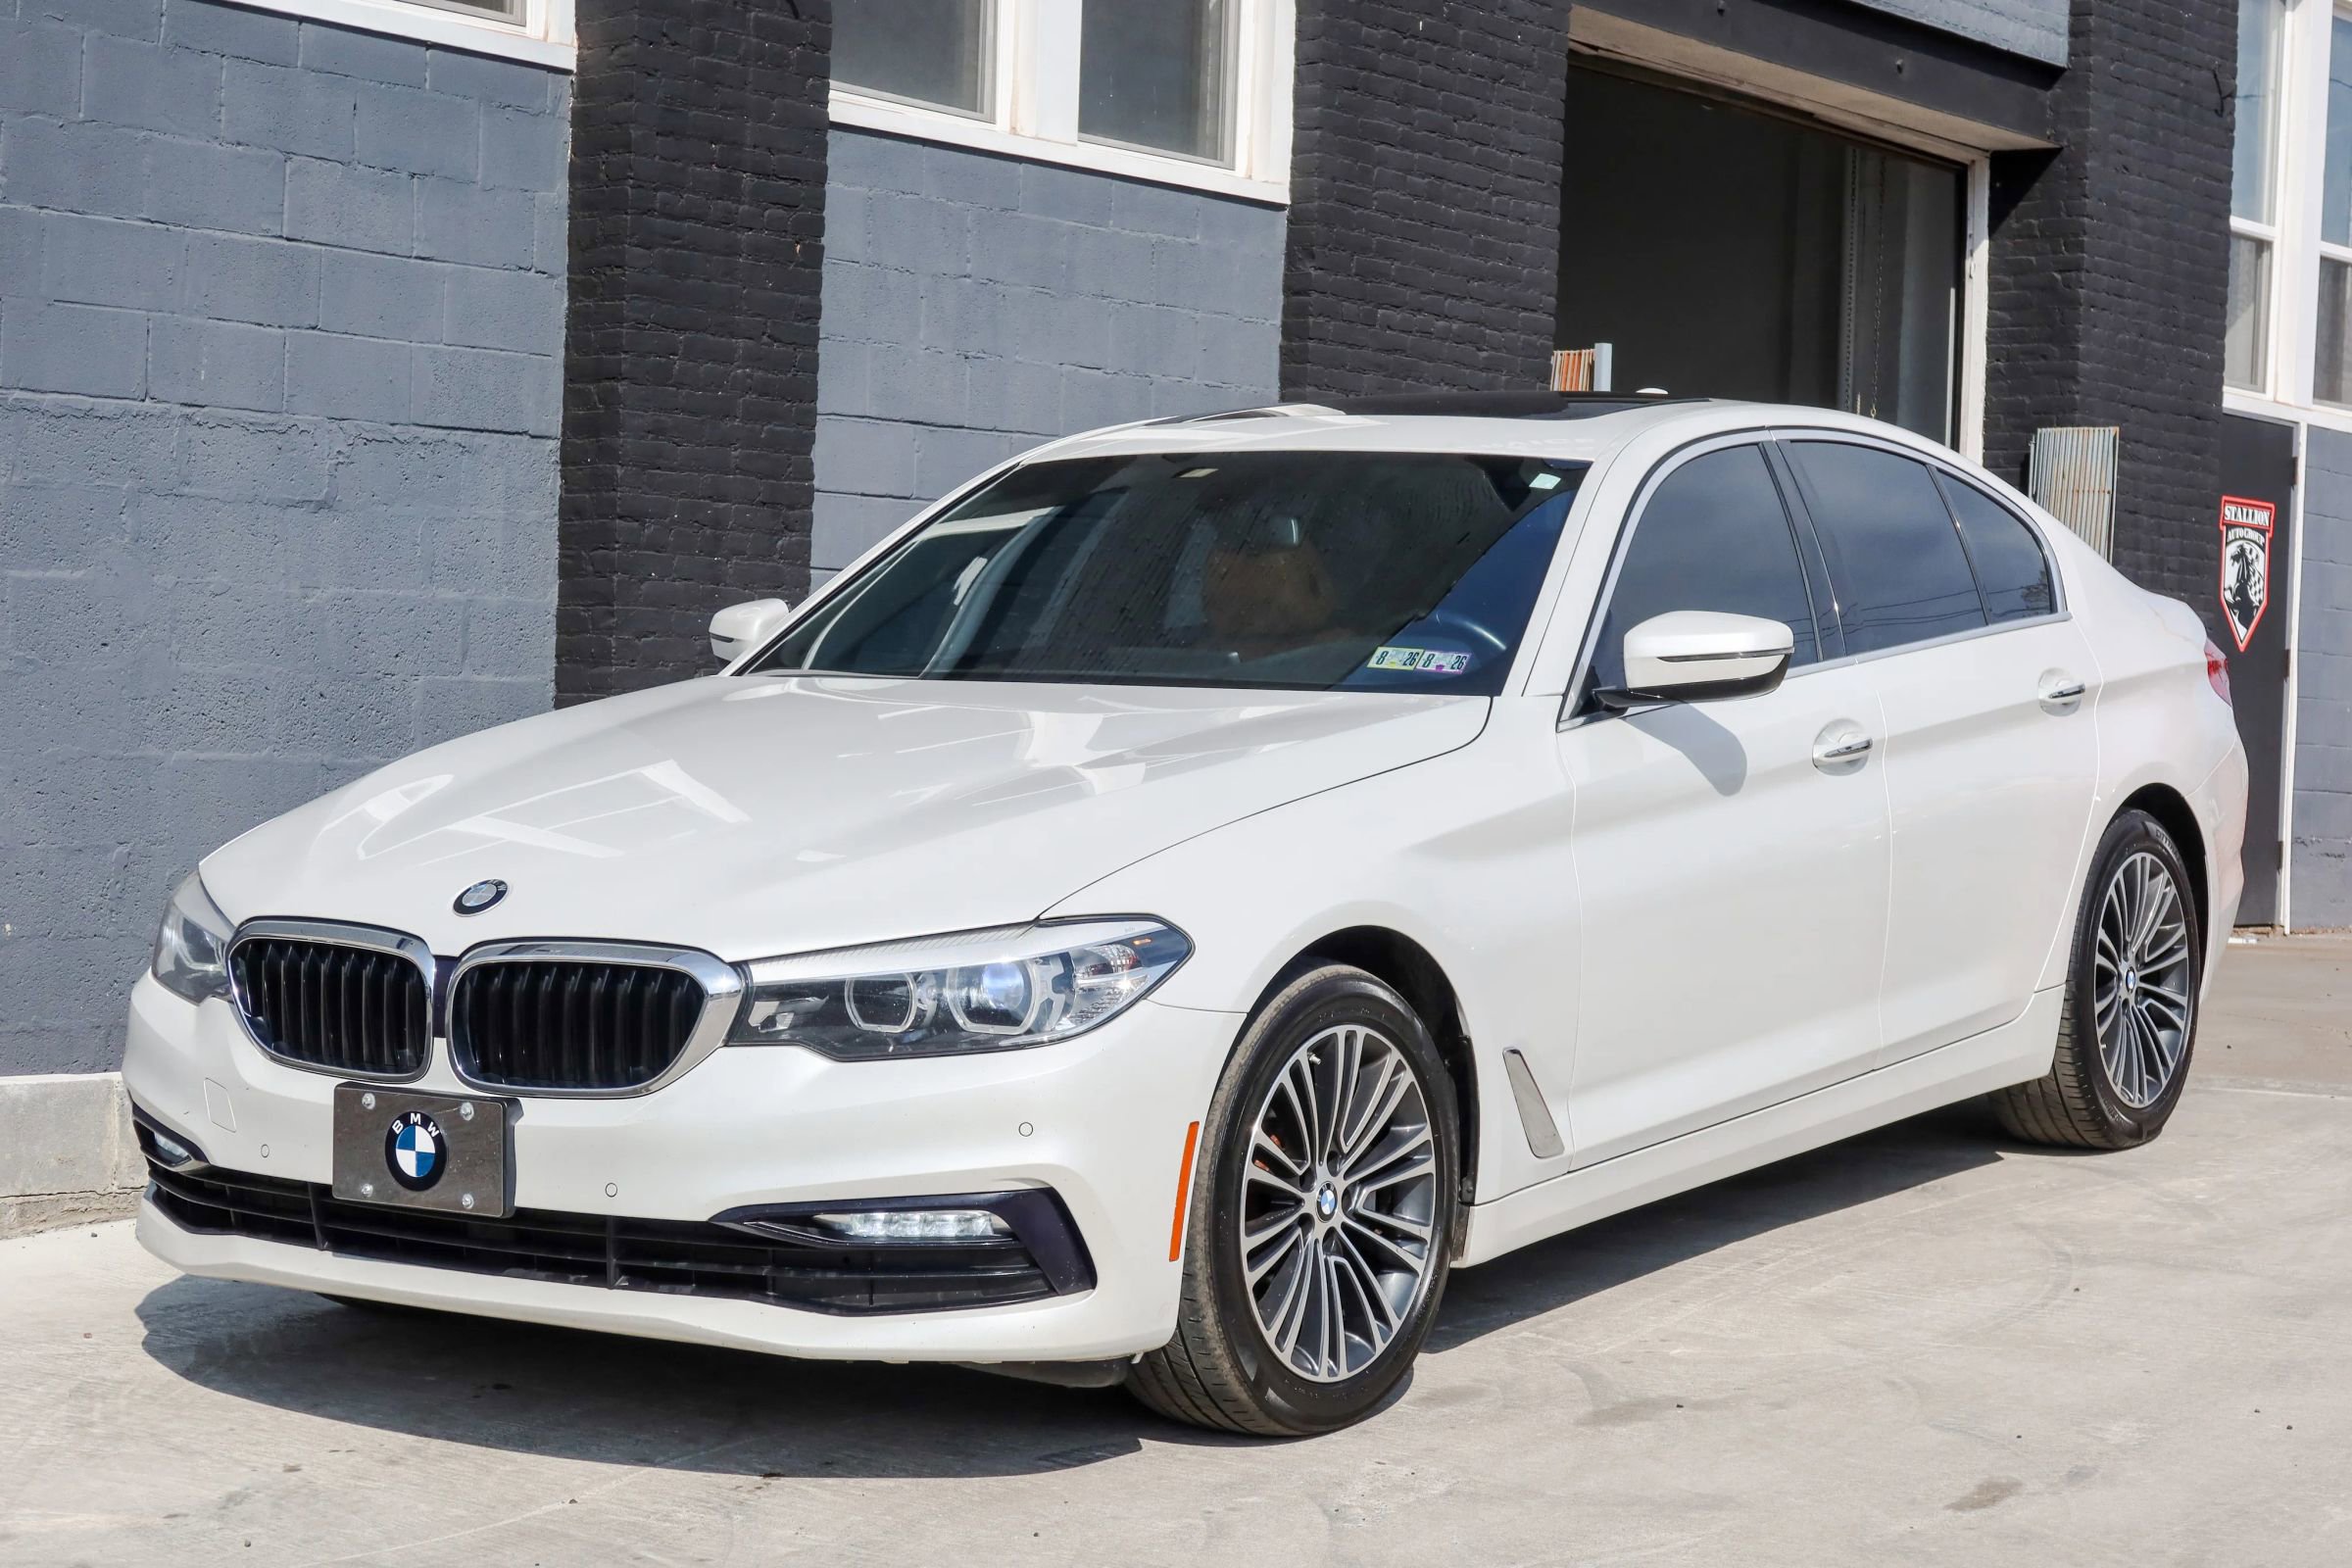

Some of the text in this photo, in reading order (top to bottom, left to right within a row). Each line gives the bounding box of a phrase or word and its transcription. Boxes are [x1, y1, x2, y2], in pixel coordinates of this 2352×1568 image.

[2225, 505, 2270, 526] STALLION
[1376, 651, 1420, 666] 8 26
[1423, 654, 1467, 669] 8 26
[392, 1112, 440, 1137] BMW
